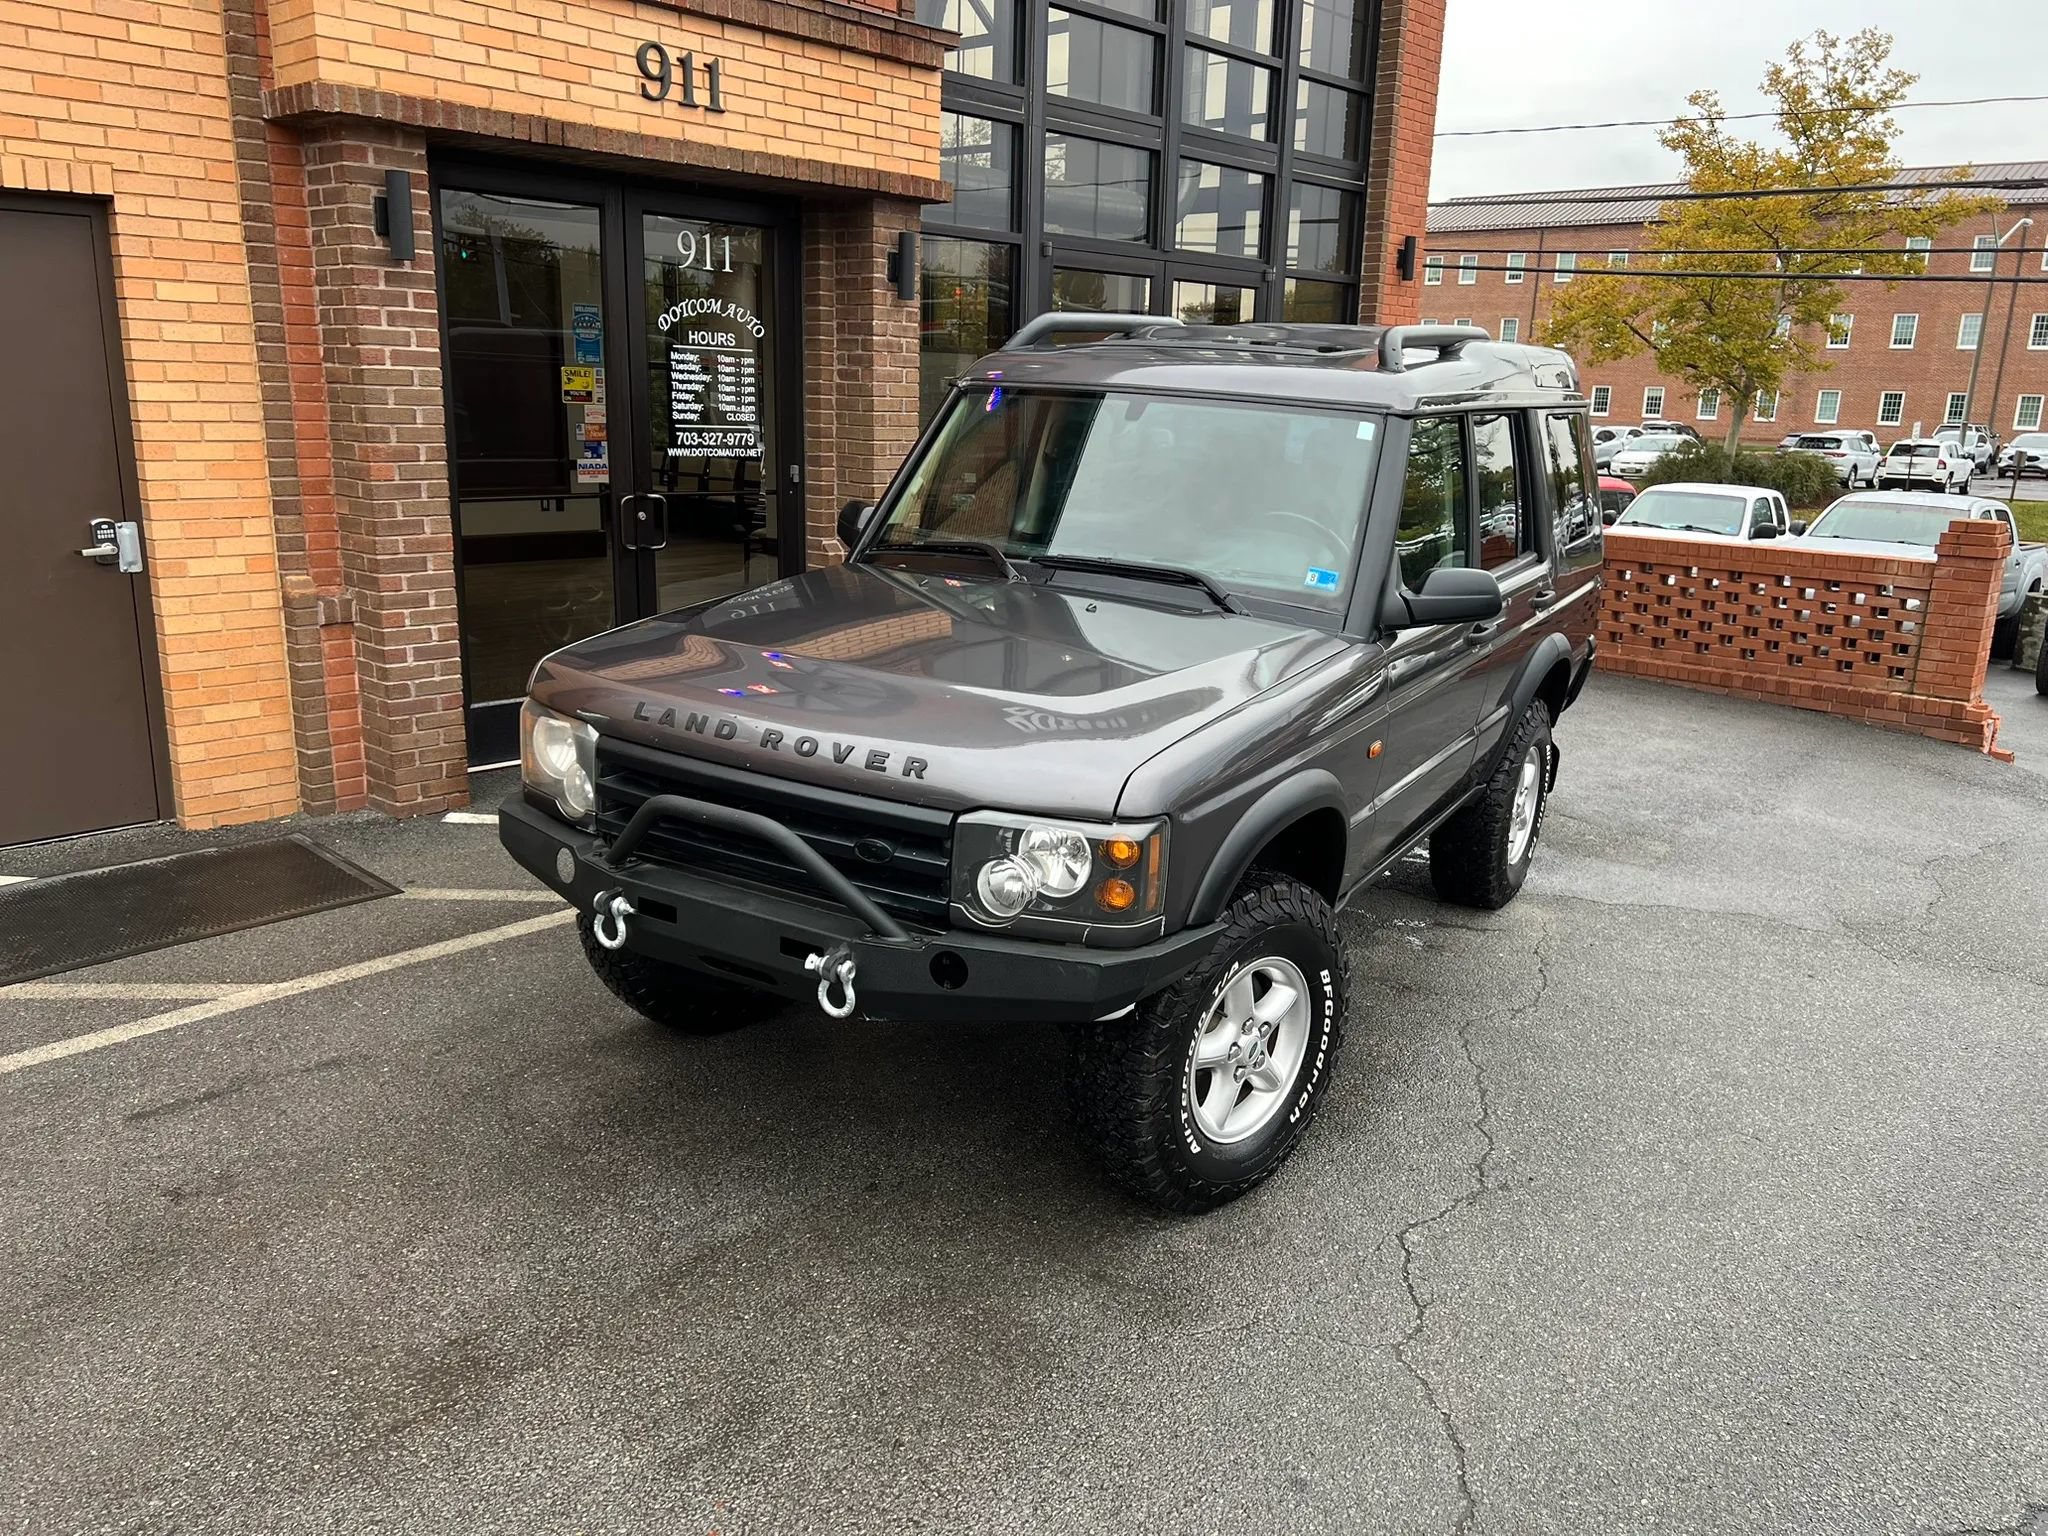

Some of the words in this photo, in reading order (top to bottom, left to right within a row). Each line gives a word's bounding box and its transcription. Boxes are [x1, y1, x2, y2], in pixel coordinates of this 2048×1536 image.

[636, 41, 726, 113] 911
[677, 230, 734, 273] 911
[658, 298, 722, 332] DOTCOM
[721, 303, 765, 338] AUTO
[688, 330, 736, 346] HOURS
[670, 351, 700, 362] Monday:
[717, 355, 735, 363] 10am
[671, 362, 702, 372] Tuesday:
[717, 364, 735, 373] 10am
[671, 371, 712, 383] Wednesday:
[717, 374, 736, 383] 10am
[671, 381, 705, 392] Thursday:
[718, 384, 736, 392] 10am
[671, 391, 695, 402] Friday:
[718, 393, 736, 402] 10am
[672, 401, 704, 412] Saturday:
[718, 403, 736, 412] 10am
[672, 411, 700, 421] Sunday:
[726, 413, 756, 421] CLOSED
[676, 432, 755, 446] 703-327-9779
[667, 448, 762, 457] WWW.DOTCOMAUTO.NET
[633, 701, 738, 741] LAND
[759, 727, 929, 780] ROVER
[1290, 969, 1334, 1123] BFGoodrich
